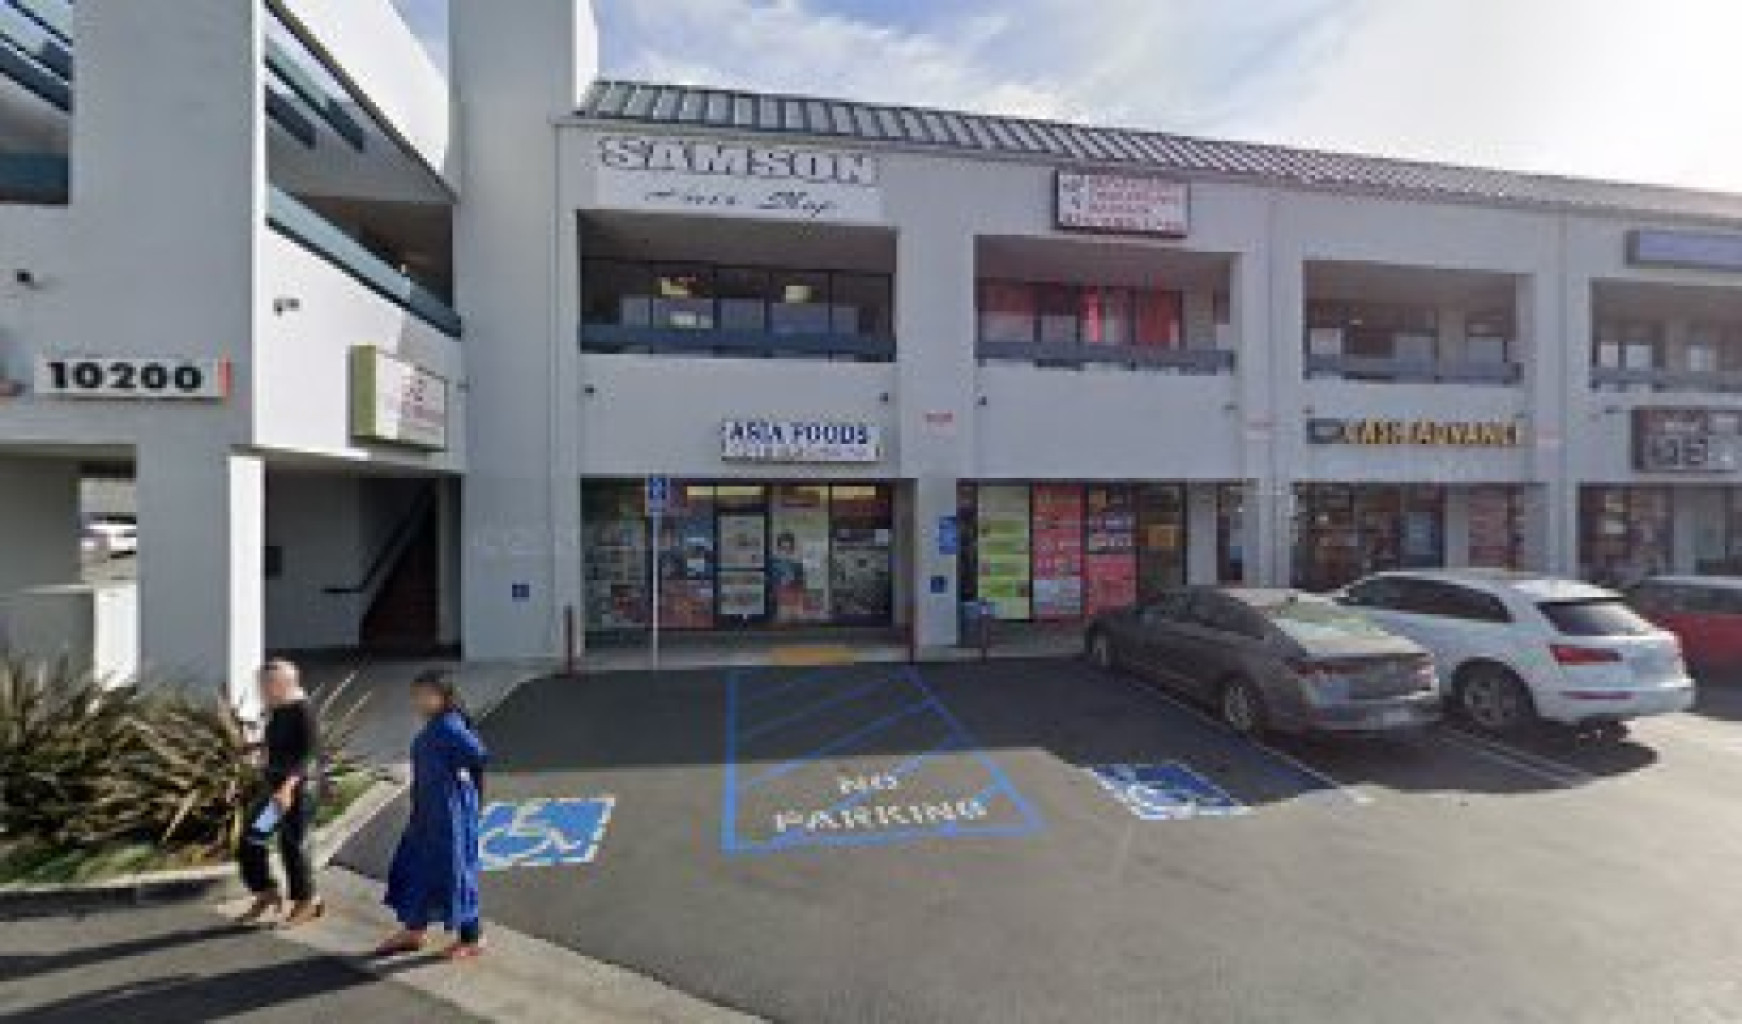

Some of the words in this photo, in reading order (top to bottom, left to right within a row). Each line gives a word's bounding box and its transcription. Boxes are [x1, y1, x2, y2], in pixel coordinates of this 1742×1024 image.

[598, 135, 878, 187] SAMSON
[48, 361, 203, 392] 10200
[729, 421, 783, 444] ASIA
[791, 422, 868, 445] FOODS
[837, 774, 898, 795] NO
[774, 800, 988, 833] PARKING
